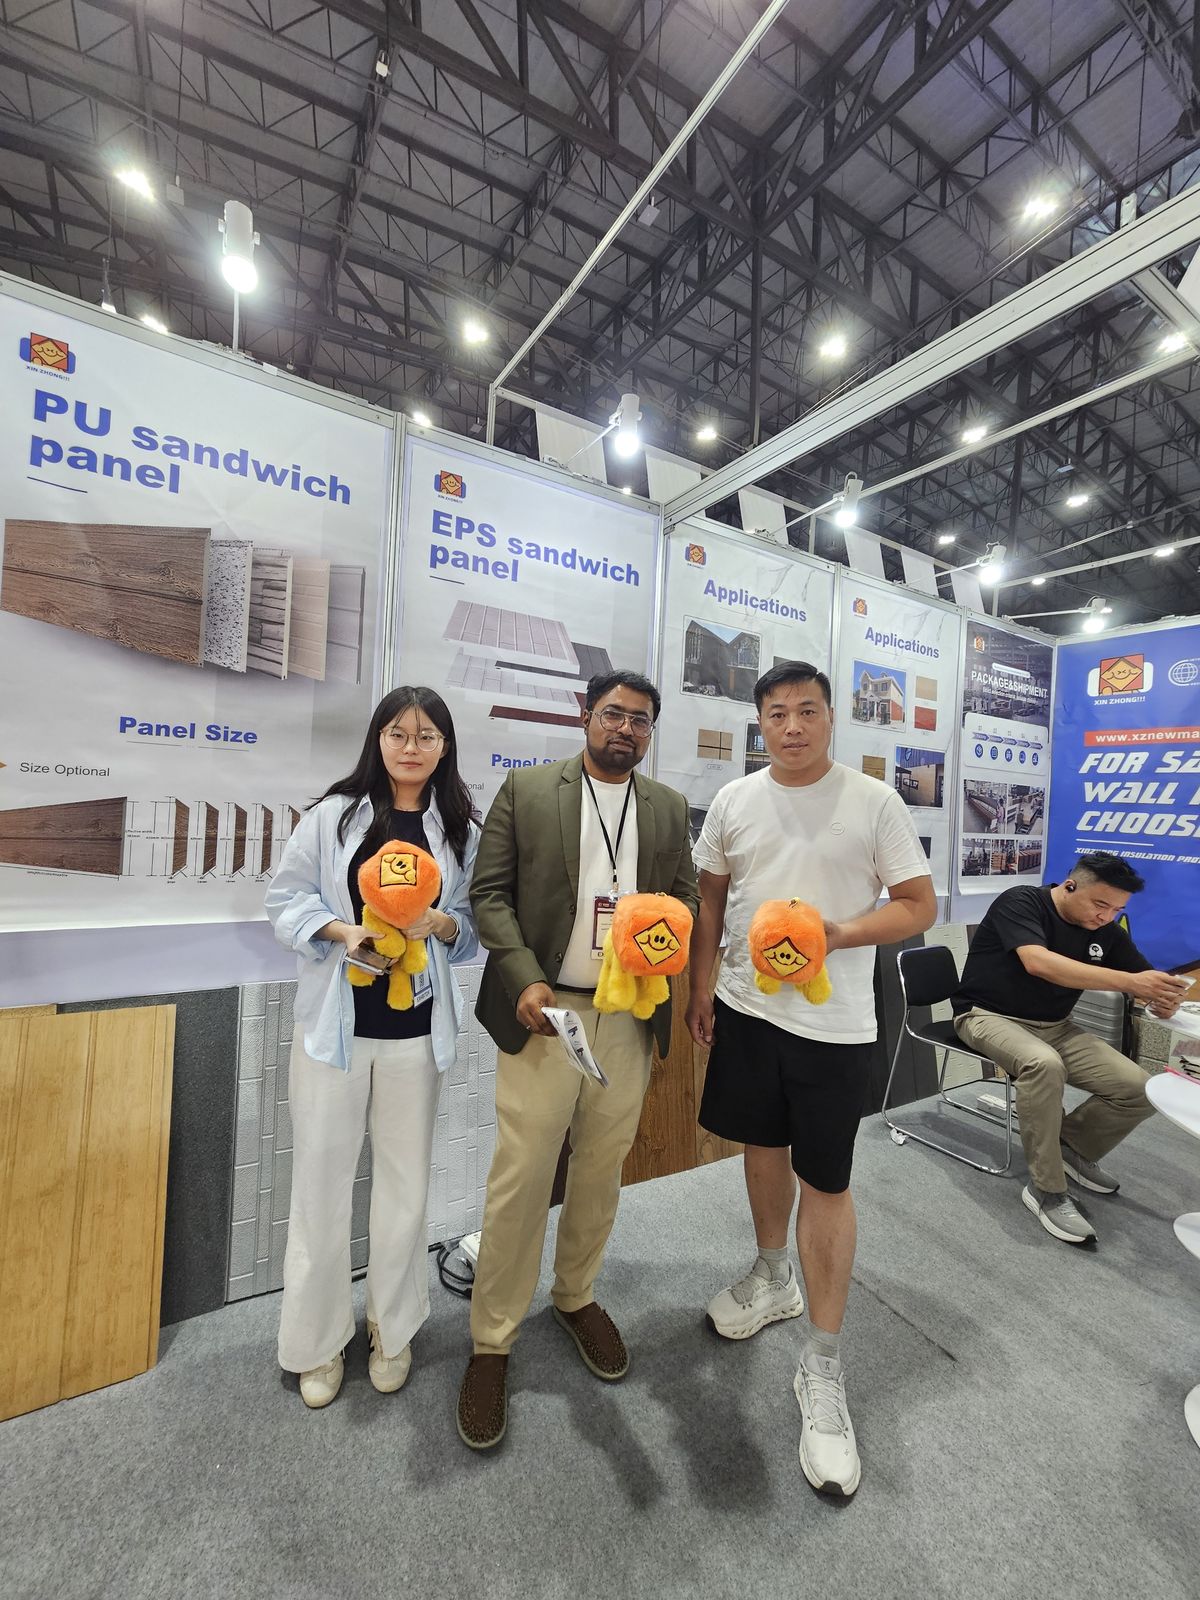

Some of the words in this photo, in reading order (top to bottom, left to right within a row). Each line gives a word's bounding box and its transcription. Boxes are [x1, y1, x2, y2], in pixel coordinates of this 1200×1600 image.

[29, 434, 181, 494] panel
[33, 388, 112, 437] PU
[131, 425, 351, 505] sandwich
[429, 543, 519, 582] panel
[432, 509, 497, 548] EPS
[507, 536, 640, 587] sandwich
[703, 578, 807, 622] Applications
[864, 626, 940, 659] Applications
[1109, 696, 1146, 705] ZHONG!!!
[119, 716, 196, 739] Panel
[205, 724, 258, 744] Size
[19, 762, 50, 774] Size
[54, 764, 110, 777] Optional
[1078, 751, 1150, 774] FOR
